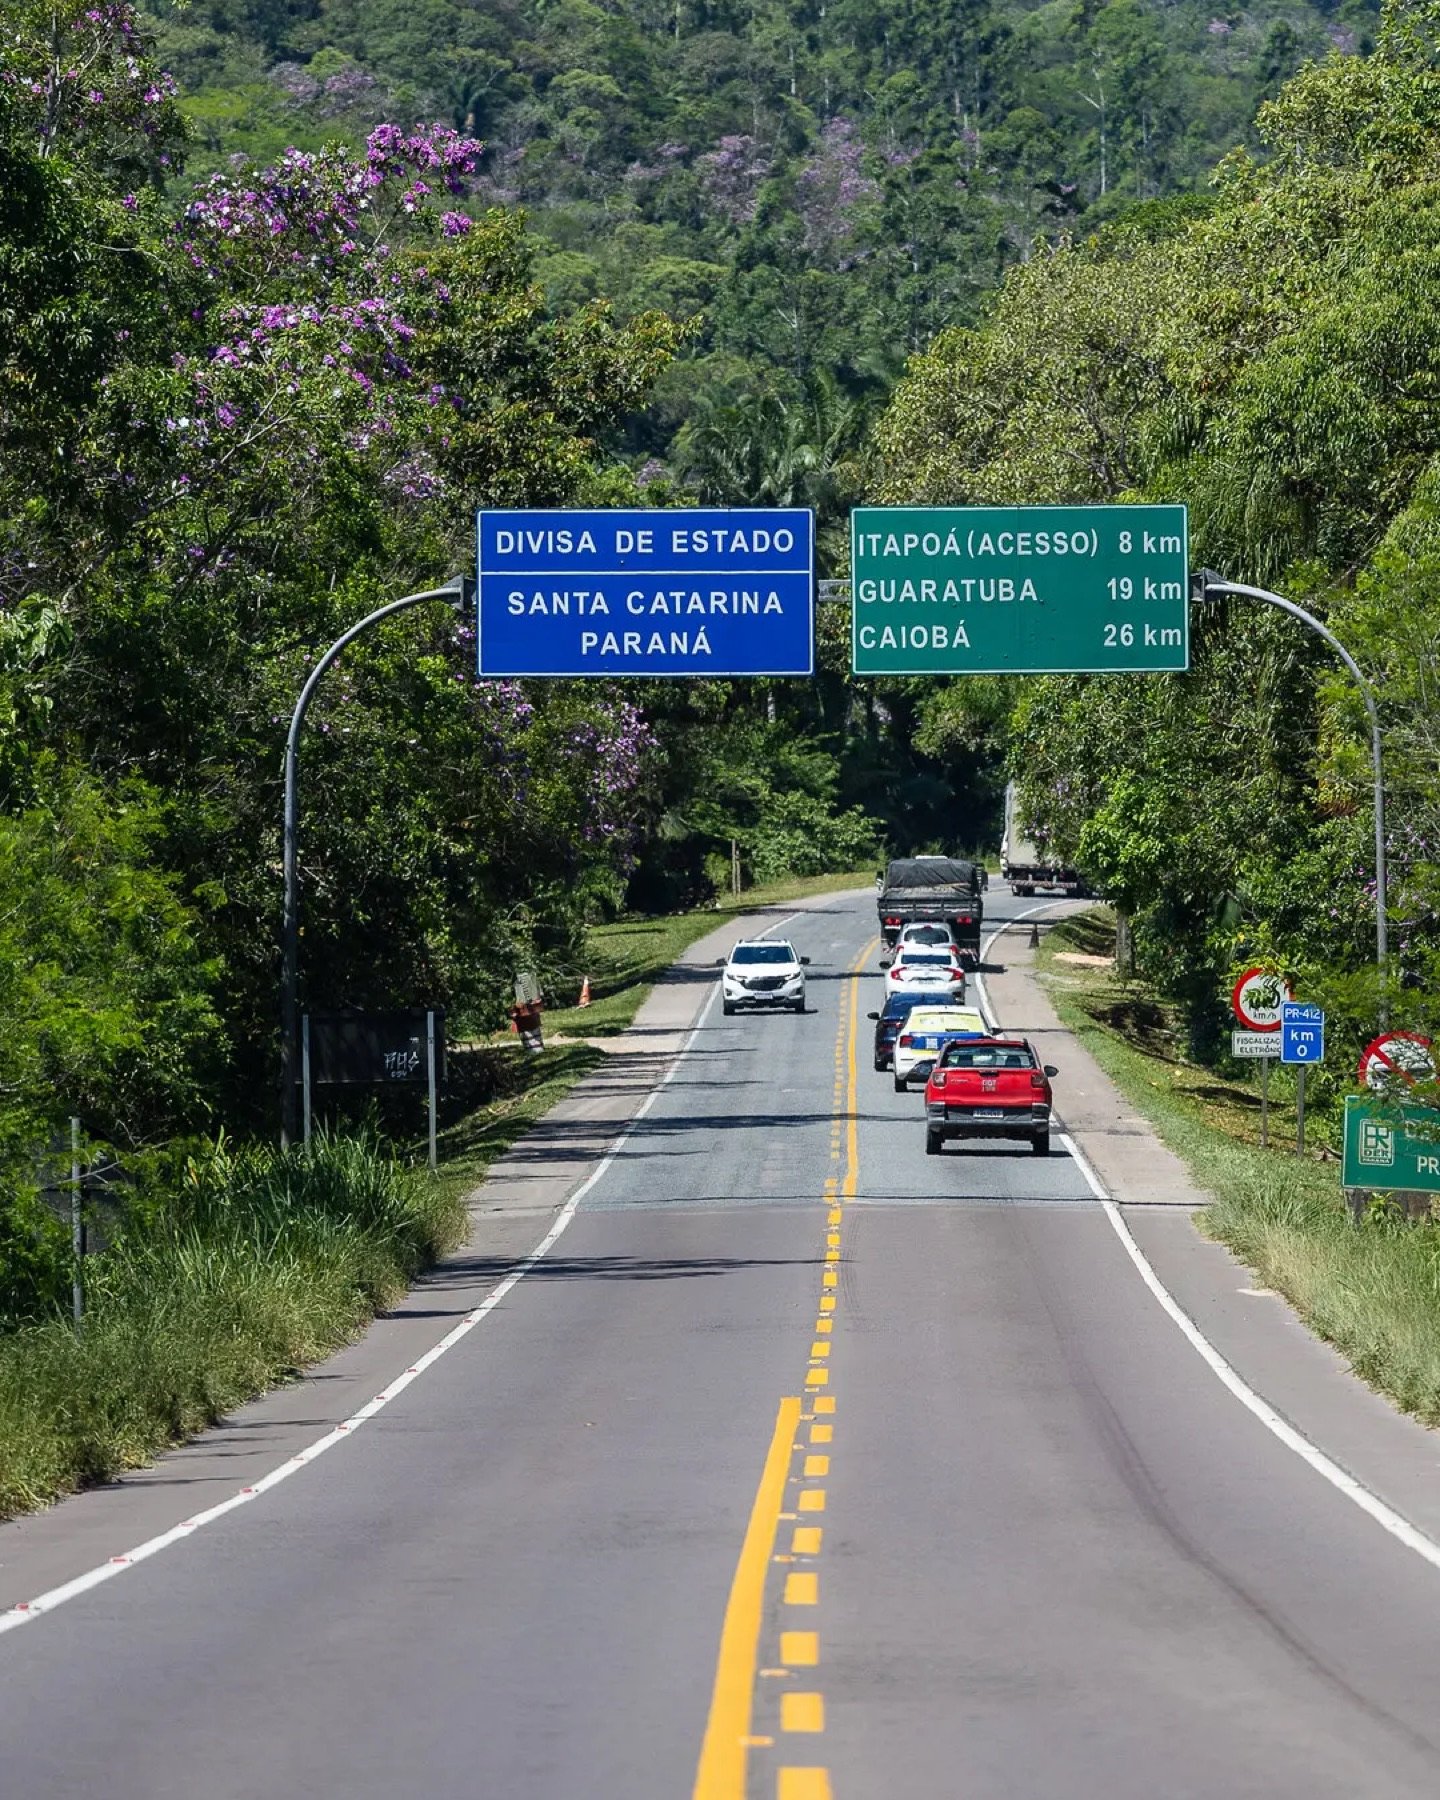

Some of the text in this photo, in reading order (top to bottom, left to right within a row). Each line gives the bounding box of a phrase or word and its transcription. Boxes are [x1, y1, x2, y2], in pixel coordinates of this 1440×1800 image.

[496, 528, 794, 554] DIVISA DE ESTADO
[858, 527, 961, 557] ITAPOÁ
[1119, 531, 1133, 554] 8
[1143, 531, 1181, 553] km
[858, 576, 1181, 603] GUARATUBA 19 km
[507, 591, 784, 615] SANTA CATARINA
[581, 625, 712, 655] PARANÁ
[859, 619, 1181, 649] CAIOBÁ 26 km
[1284, 1008, 1321, 1020] PR-412
[1290, 1029, 1314, 1042] km
[1296, 1044, 1308, 1057] 0
